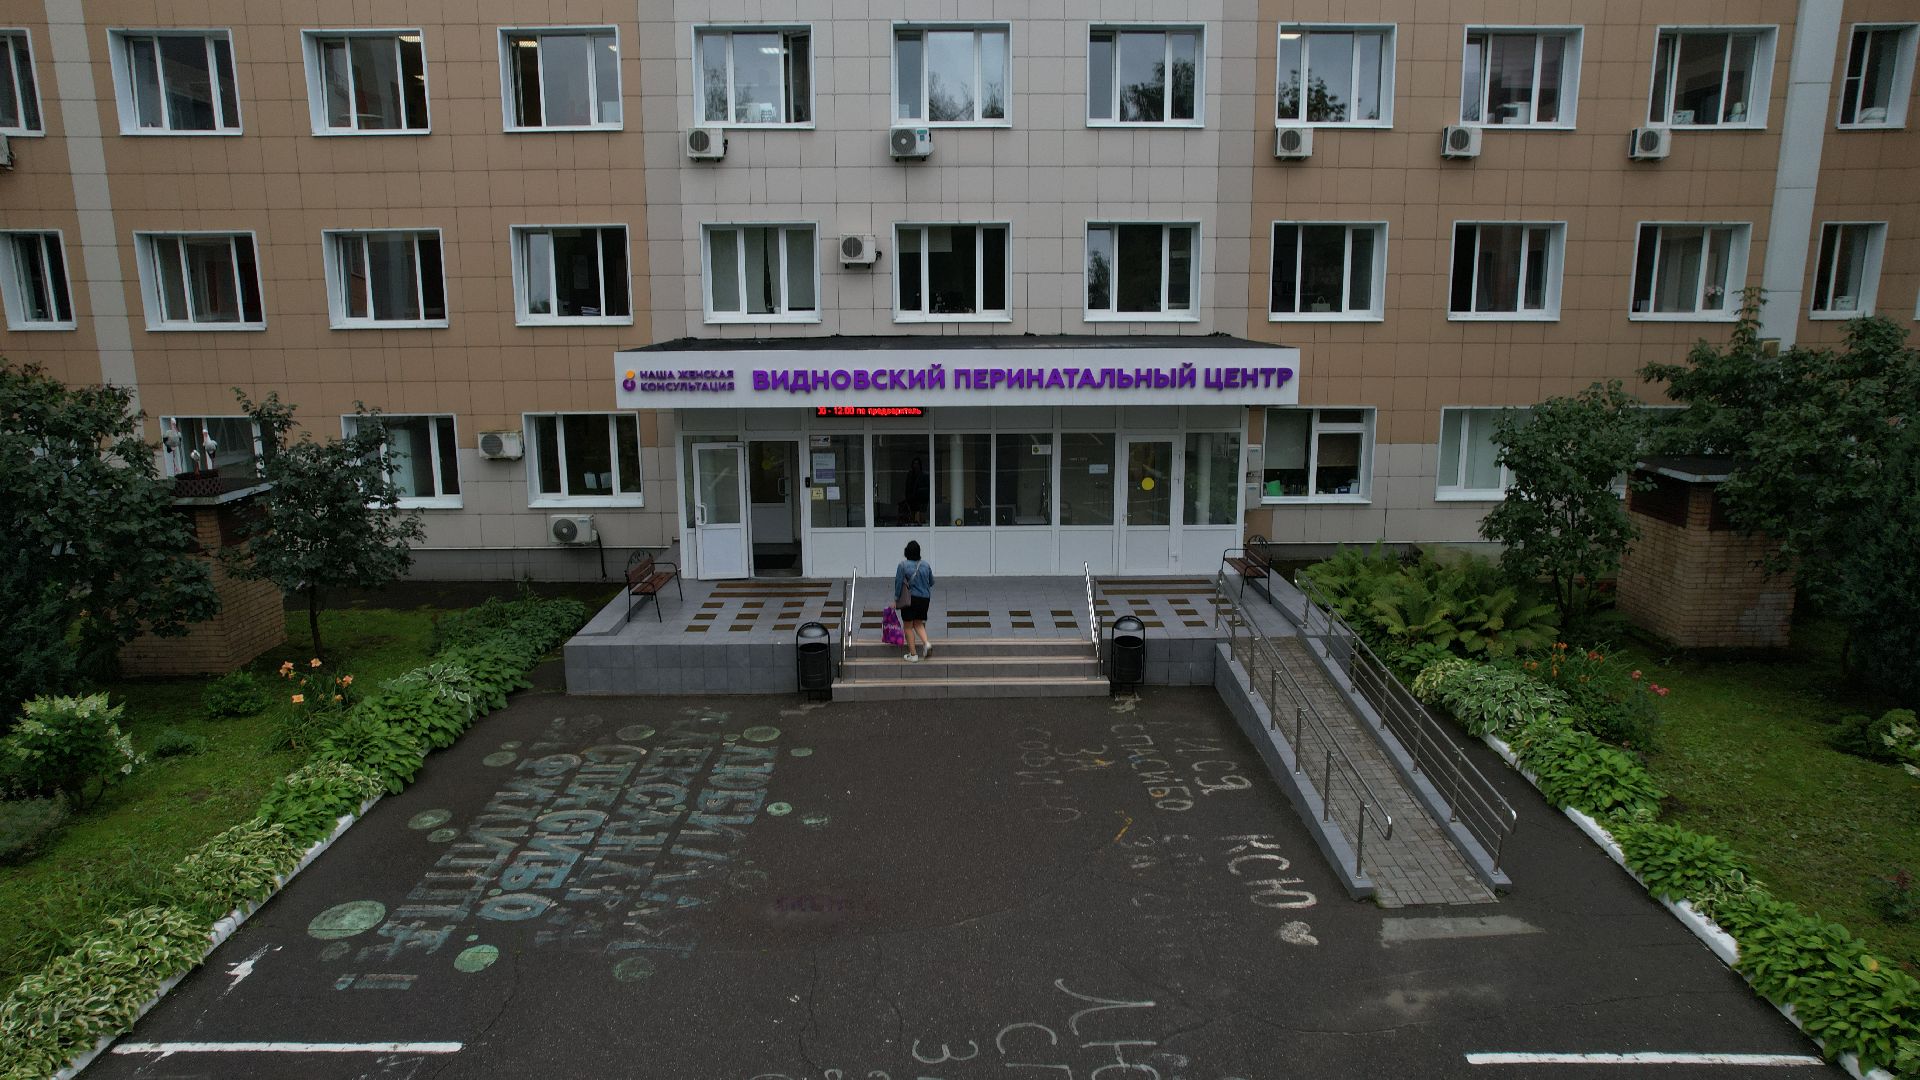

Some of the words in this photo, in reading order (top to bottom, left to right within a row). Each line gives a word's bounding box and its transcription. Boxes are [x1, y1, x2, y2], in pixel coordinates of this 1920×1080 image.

[640, 370, 675, 380] НАША
[678, 370, 734, 380] ЖЕНСКАЯ
[640, 382, 735, 393] КОНСУЛЬТАЦИЯ
[752, 363, 946, 394] ВИДНОВСКИЙ
[953, 362, 1197, 391] ПЕРИНАТАЛЬНЫЙ
[1204, 367, 1294, 392] ЦЕНТР
[833, 406, 854, 415] 12.00
[868, 407, 922, 416] предваритель
[1055, 743, 1114, 772] ЗА
[1110, 723, 1194, 811] СПАСИБО
[475, 744, 647, 921] СПАСИБО
[1218, 833, 1317, 909] КСЮ
